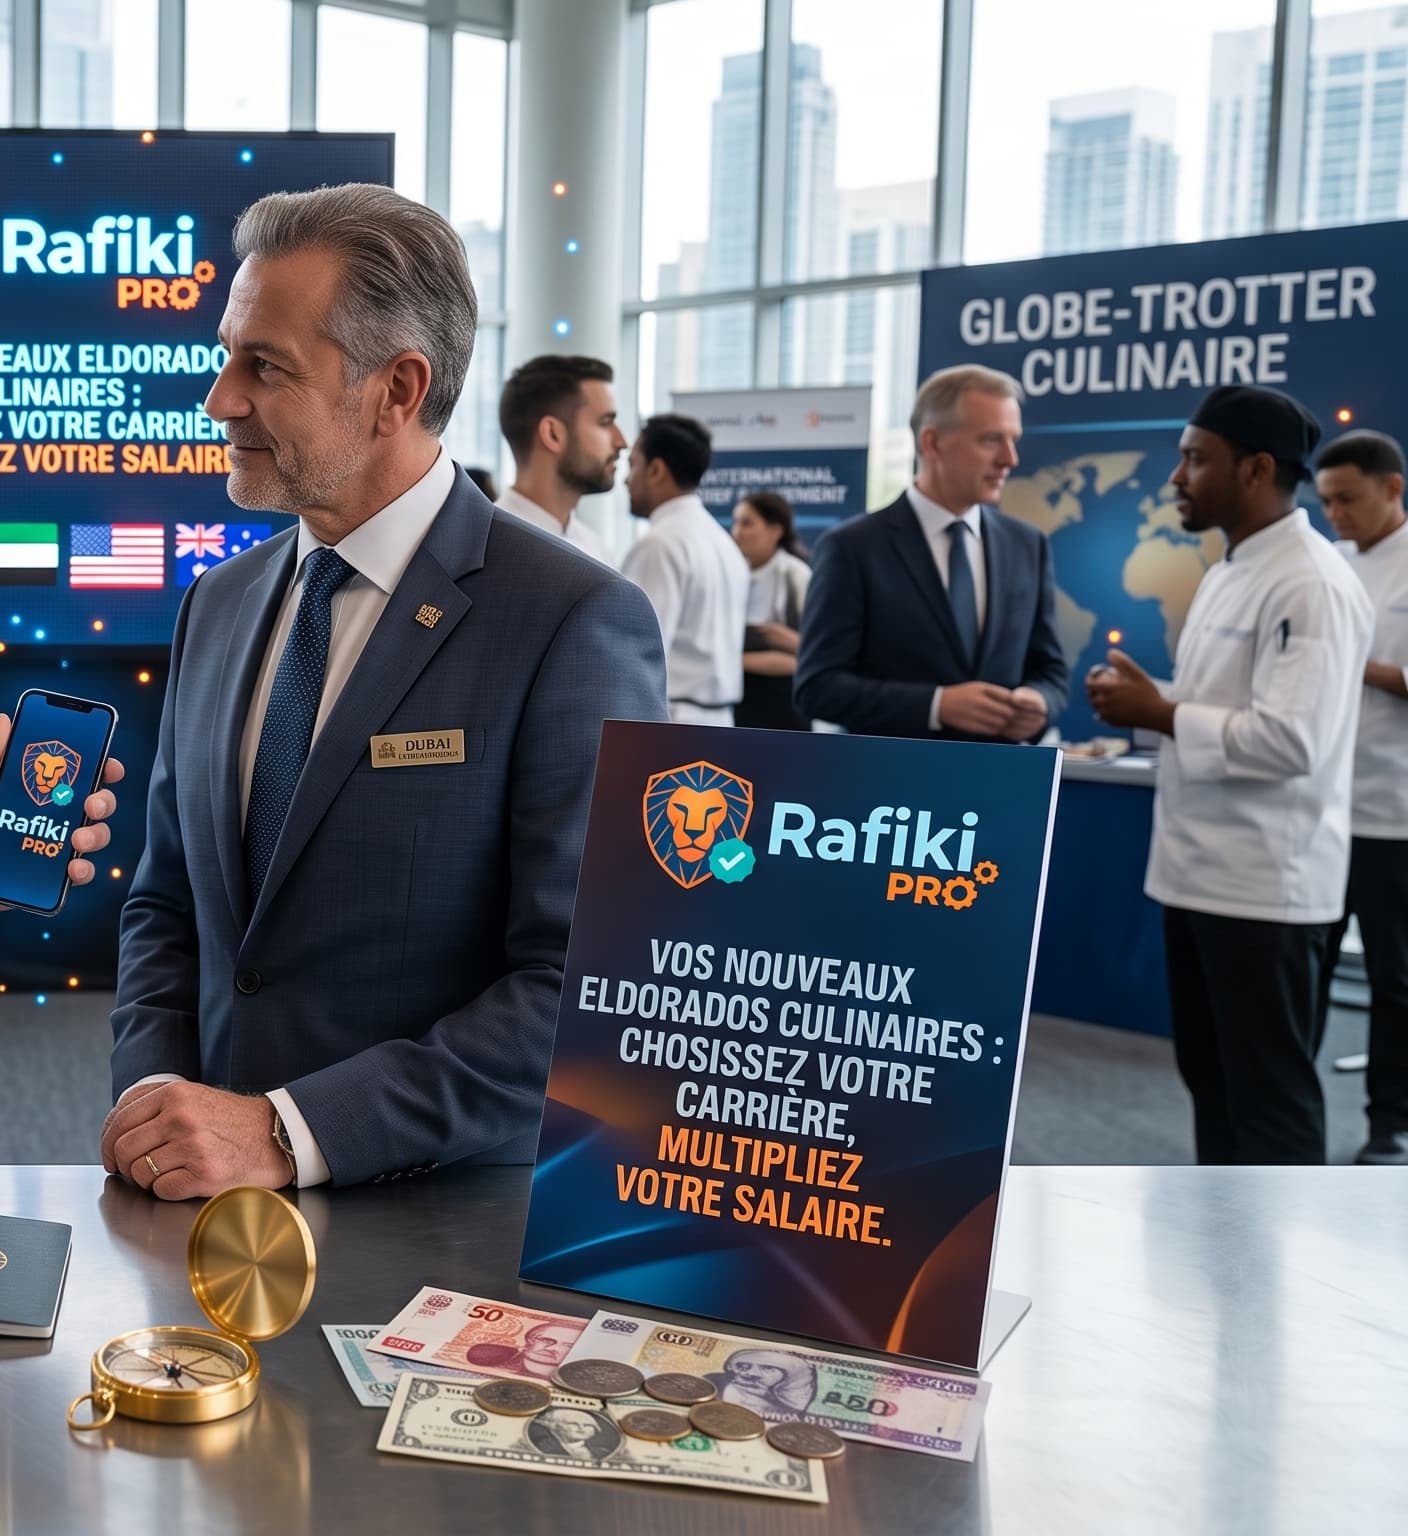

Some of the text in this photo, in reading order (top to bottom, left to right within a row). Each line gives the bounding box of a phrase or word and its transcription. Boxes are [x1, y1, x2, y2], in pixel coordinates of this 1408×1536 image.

[1, 215, 194, 275] Rafiki
[117, 278, 201, 310] PRO
[960, 266, 1377, 346] GLOBE-TROTTER
[79, 344, 229, 374] ELDORADO
[1021, 333, 1289, 397] CULINAIRE
[8, 411, 101, 440] VOTRE
[107, 402, 227, 441] CARRIÈR
[133, 384, 141, 407] :
[23, 443, 115, 473] VOTRE
[405, 738, 451, 751] DUBAI
[21, 837, 60, 858] PRO
[767, 801, 979, 873] Rafiki
[886, 873, 978, 911] PRO
[650, 938, 915, 1005] VOS NOUVEAUX
[578, 976, 1004, 1065] ELDORADOS CULINAIRES :
[619, 1027, 935, 1105] CHOSISSEZ VOTRE
[676, 1081, 856, 1148] CARRIÈRE,
[657, 1125, 864, 1193] MULTIPLIEZ
[616, 1165, 892, 1247] VOTRE SALAIRE.
[468, 1304, 505, 1322] 50
